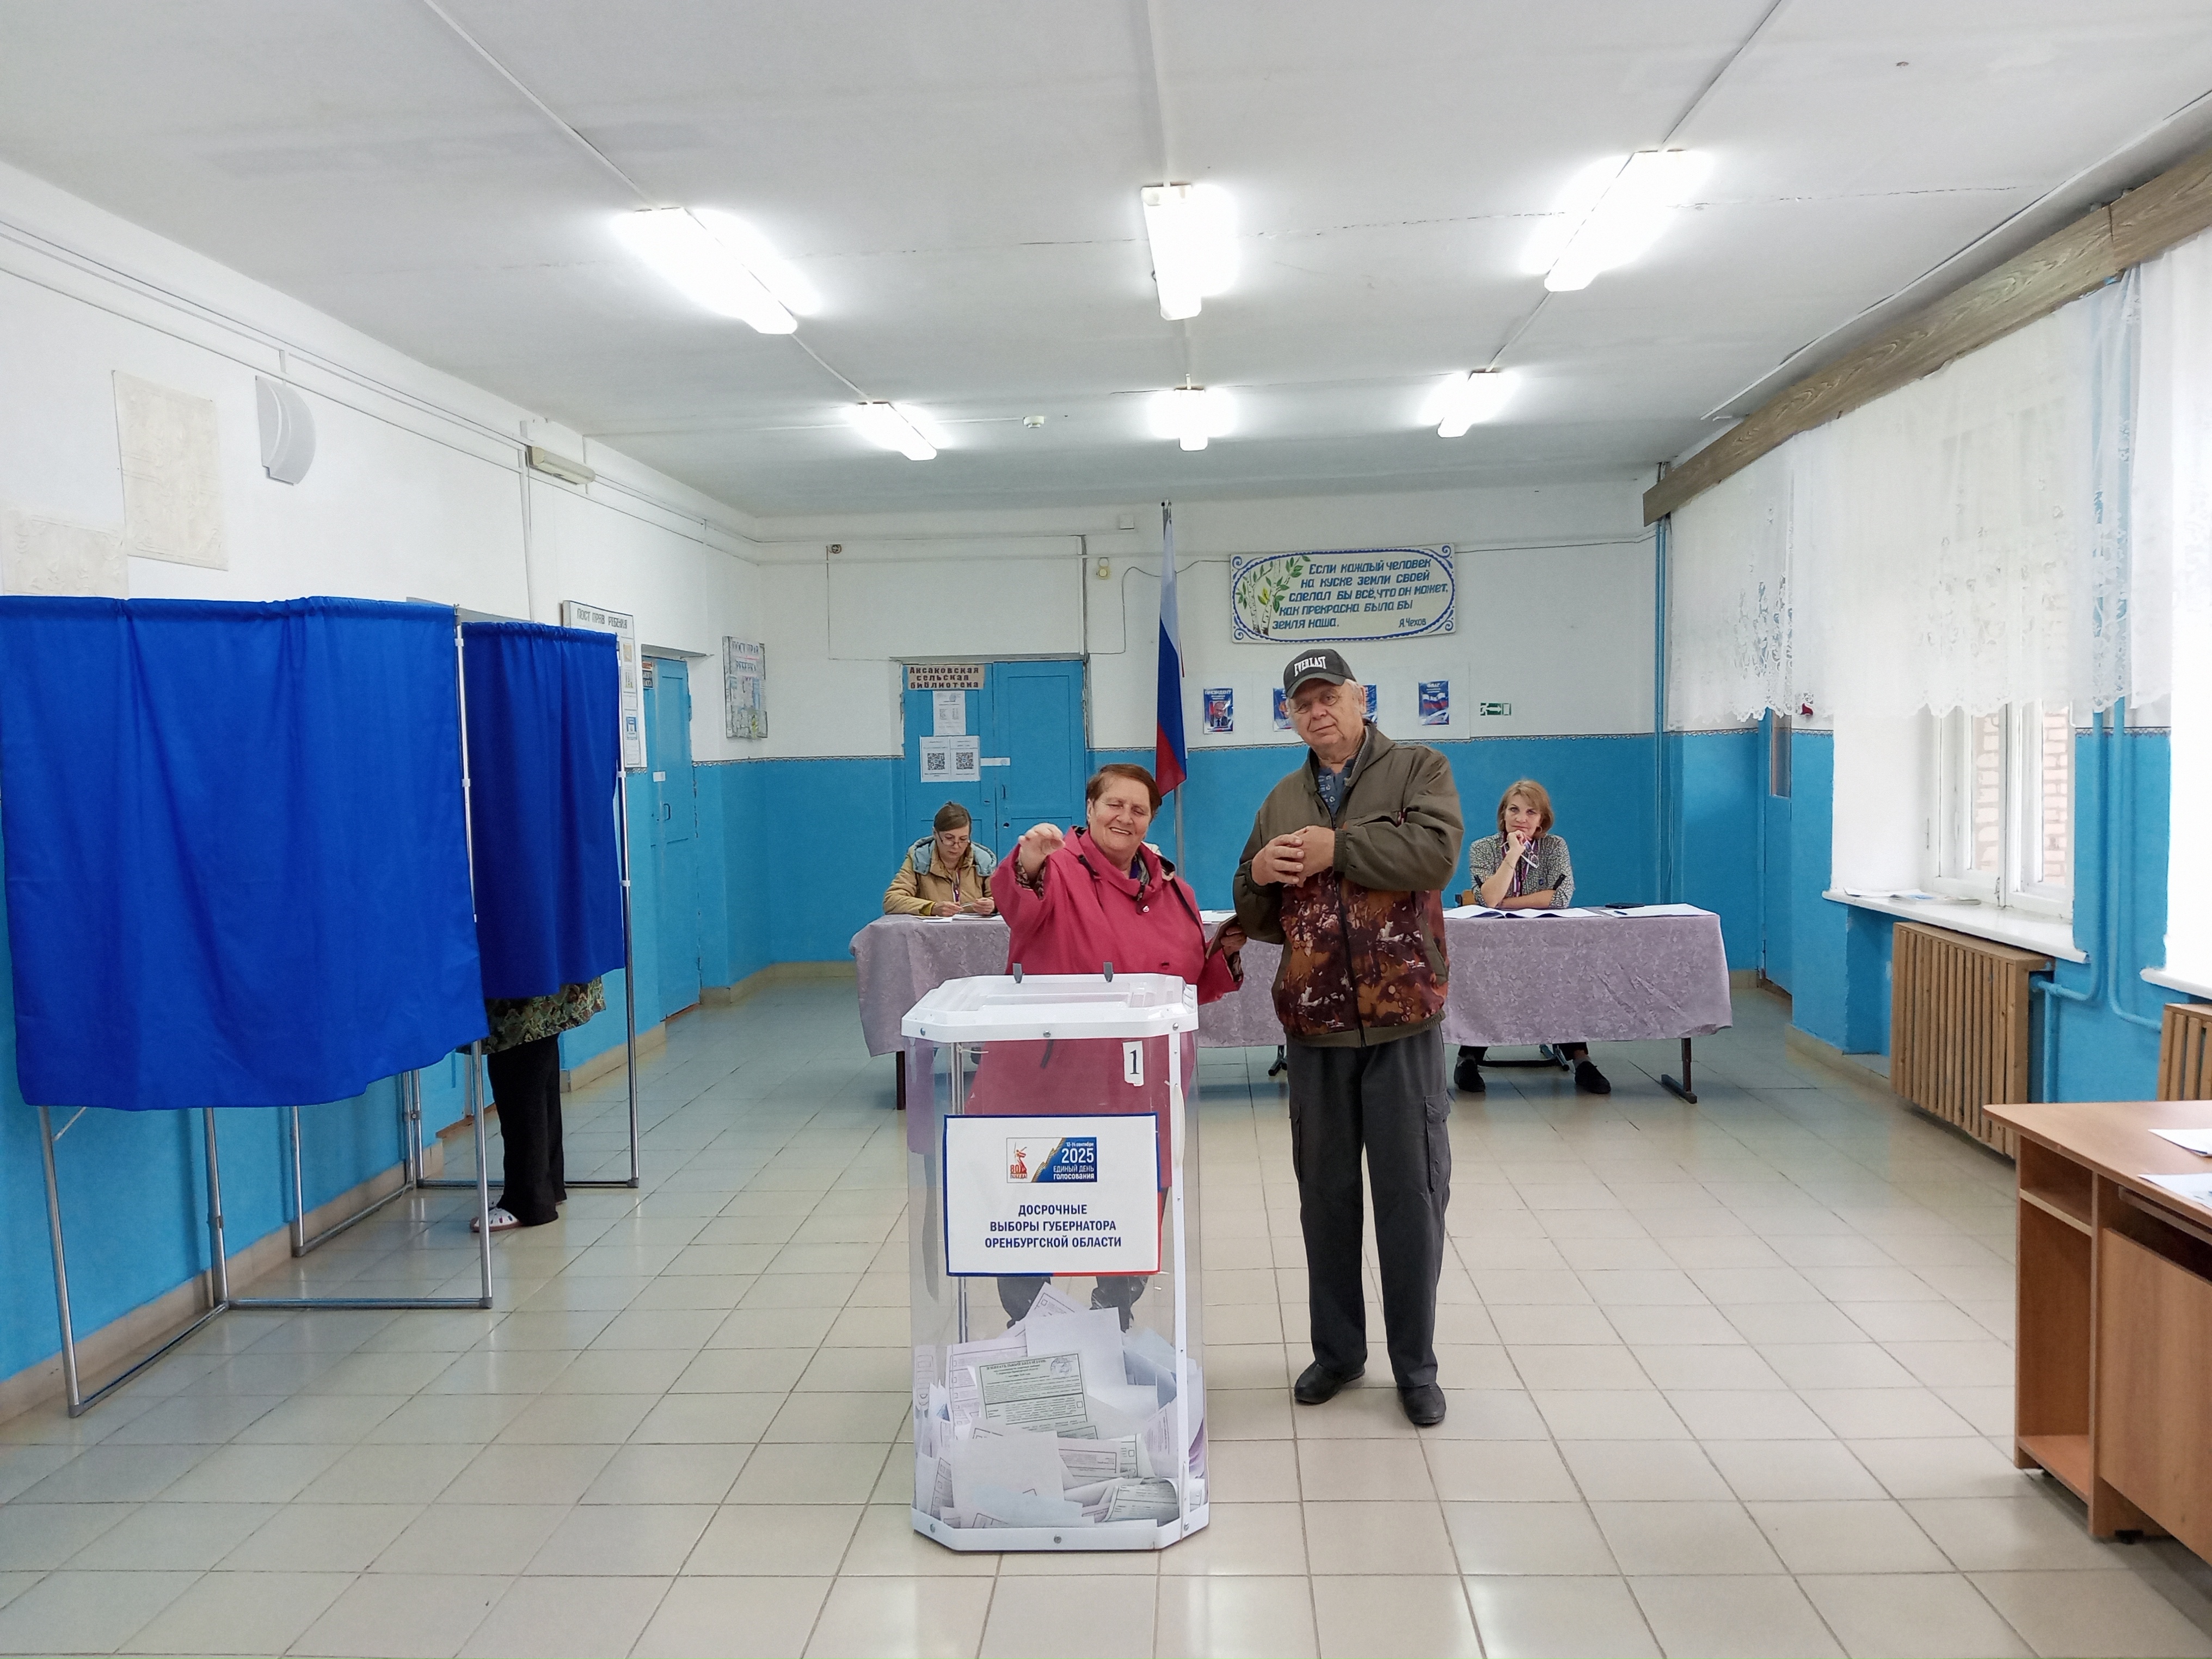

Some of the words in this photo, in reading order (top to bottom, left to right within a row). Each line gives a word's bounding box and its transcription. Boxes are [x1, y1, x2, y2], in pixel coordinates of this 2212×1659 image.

[1308, 564, 1337, 575] Если
[1340, 560, 1385, 573] каждый
[1386, 558, 1431, 570] человек
[1300, 579, 1314, 588] на
[1320, 577, 1353, 587] куске
[1357, 575, 1391, 586] земли
[1396, 570, 1430, 583] своей
[1289, 591, 1331, 602] сделал
[1398, 587, 1412, 597] он
[577, 608, 591, 622] ПОСТ
[1279, 606, 1300, 616] как
[1301, 603, 1360, 615] прекрасна
[1272, 619, 1306, 630] земля
[1308, 618, 1340, 628] наша.
[1294, 656, 1327, 677] EVERLAST
[1129, 1049, 1140, 1074] 1
[1061, 1147, 1094, 1164] 2025
[1053, 1164, 1078, 1173] ЕДИНЫЙ
[1018, 1205, 1087, 1216] ДОСРОЧНЫЕ
[990, 1221, 1039, 1232] ВЫБОРЫ
[1043, 1221, 1116, 1231] ГУБЕРНАТОРА
[985, 1235, 1068, 1248] ОРЕНБУРГСКОЙ
[1072, 1237, 1121, 1248] ОБЛАСТИ
